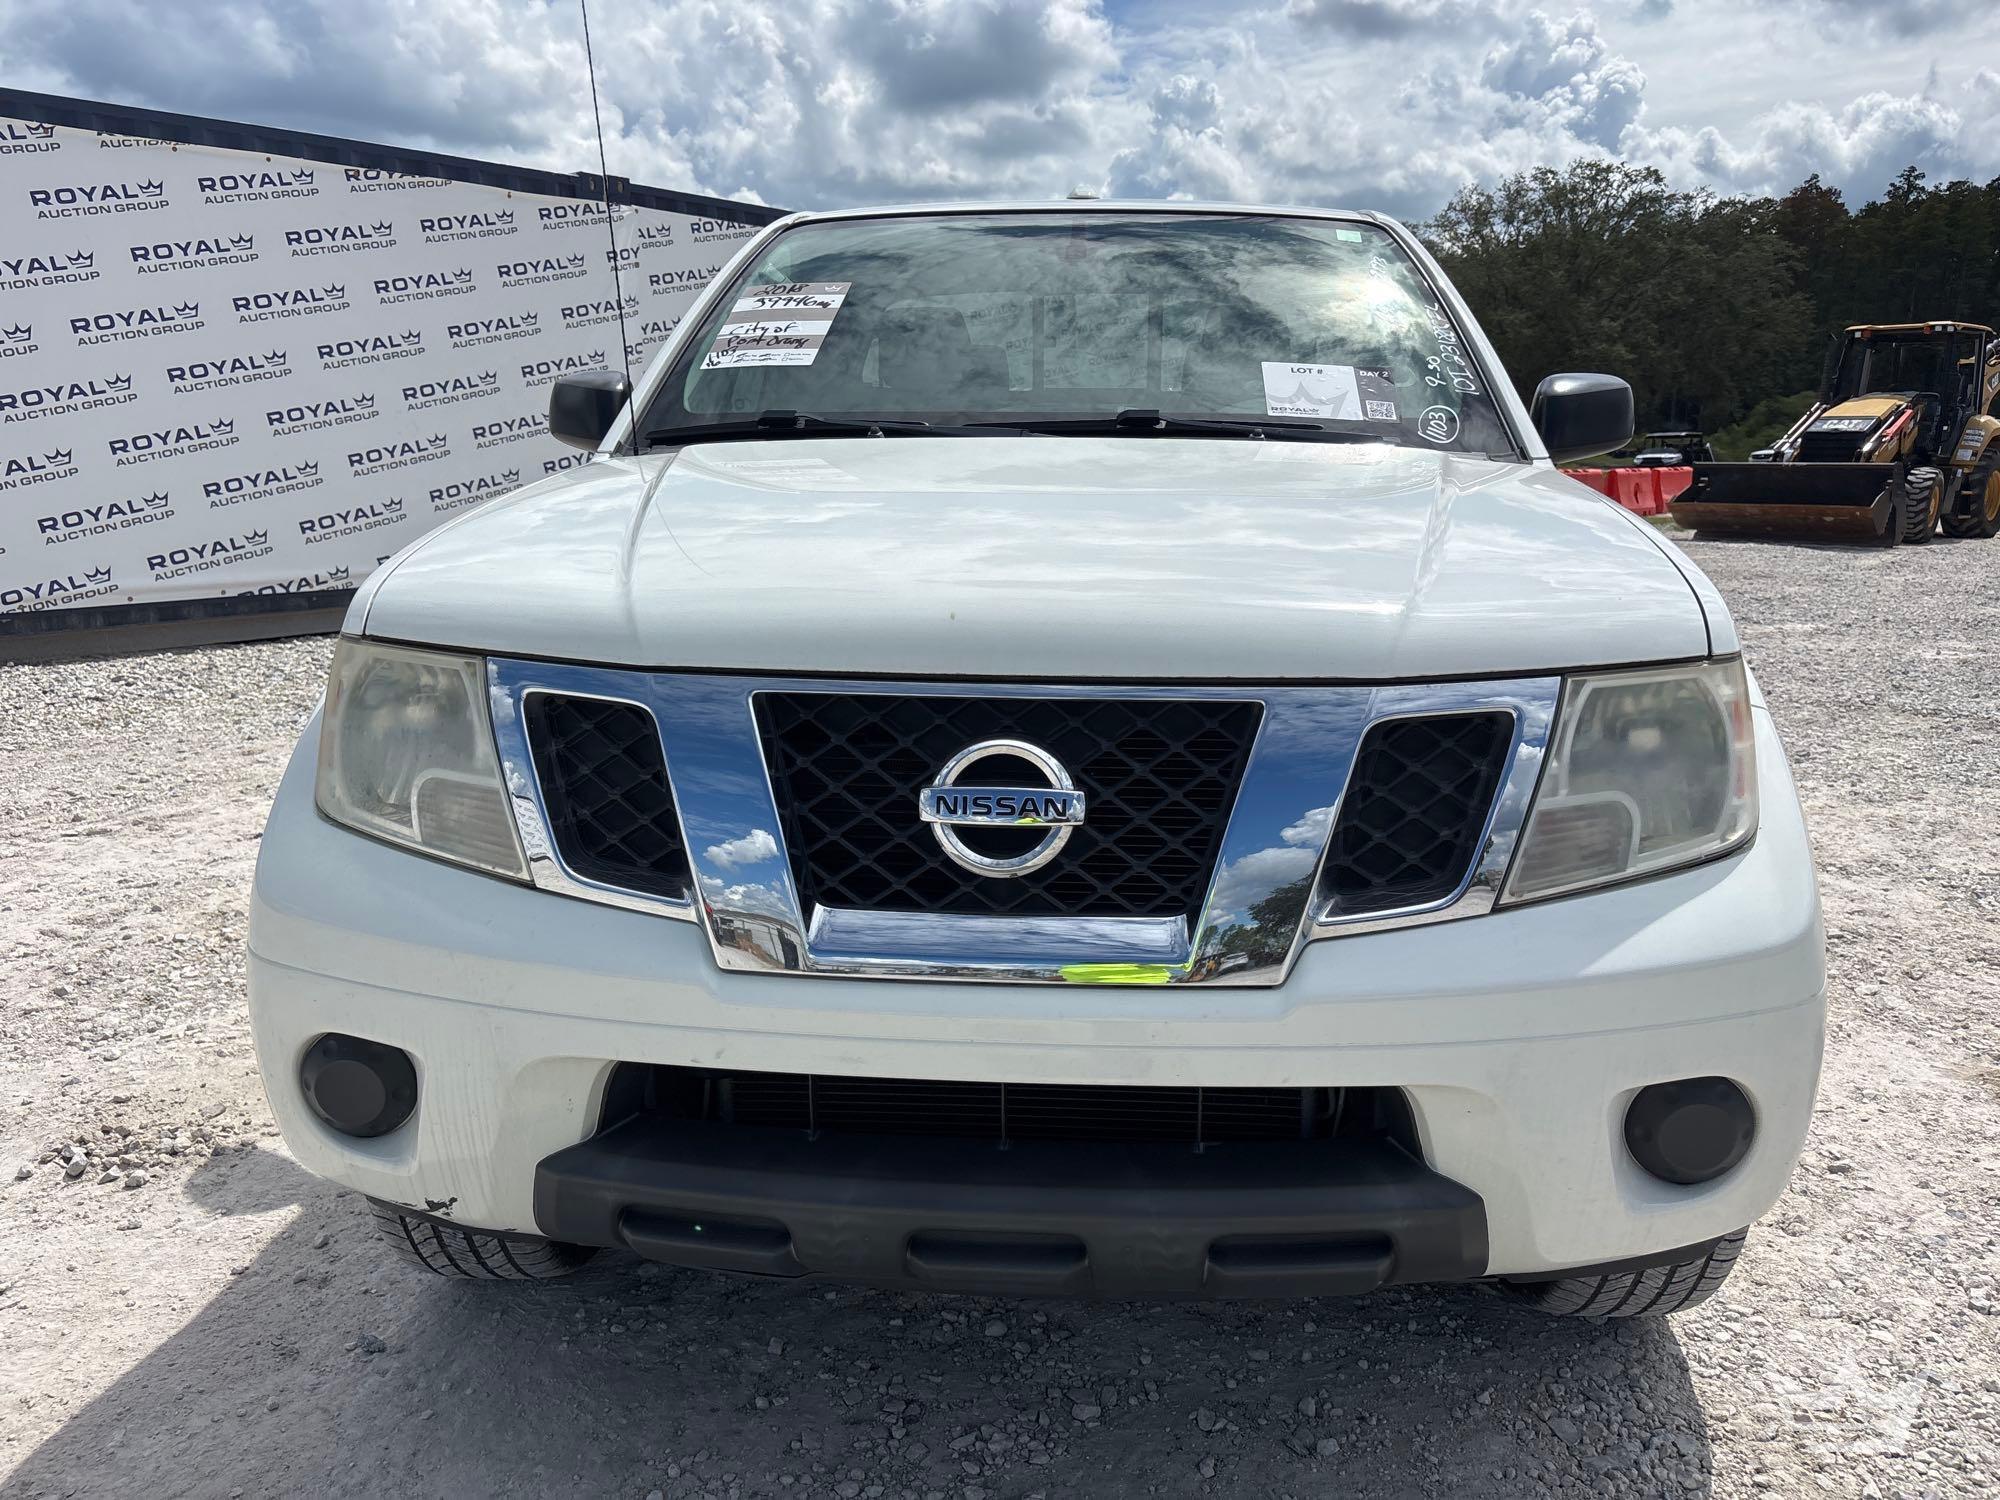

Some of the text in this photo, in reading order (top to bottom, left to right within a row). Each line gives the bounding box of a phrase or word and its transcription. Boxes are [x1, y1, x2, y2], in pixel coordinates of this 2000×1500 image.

[2, 142, 61, 154] GROUP
[198, 172, 292, 192] ROYAL
[350, 180, 452, 193] AUCTION GROUP
[30, 184, 139, 206] ROYAL
[205, 188, 319, 204] AUCTION GROUP
[38, 200, 170, 219] AUCTION GROUP
[538, 202, 606, 220] ROYAL
[420, 213, 496, 232] ROYAL
[542, 219, 589, 230] AUCTION
[285, 225, 372, 245] ROYAL
[425, 227, 518, 243] AUCTION GROUP
[642, 240, 673, 249] GROUP
[693, 234, 731, 243] AUCTION
[130, 239, 230, 262] ROYAL
[291, 239, 397, 257] AUCTION GROUP
[0, 256, 68, 276] YAL
[138, 254, 259, 274] AUCTION GROUP
[497, 258, 568, 278] ROYAL
[0, 271, 100, 290] TION GROUP
[374, 273, 454, 294] ROYAL
[502, 270, 587, 288] AUCTION GROUP
[649, 268, 707, 286] ROYAL
[232, 289, 324, 311] ROYAL
[380, 285, 476, 304] AUCTION GROUP
[652, 284, 692, 296] AUCTION
[239, 302, 350, 323] AUCTION GROUP
[561, 299, 625, 319] ROYAL
[70, 308, 175, 334] ROYAL
[448, 317, 521, 339] ROYAL
[565, 316, 609, 329] AUCTION
[78, 321, 204, 346] AUCTION GROUP
[452, 328, 542, 349] AUCTION GROUP
[317, 335, 402, 359] ROYAL
[167, 356, 264, 382] ROYAL
[323, 347, 425, 370] AUCTION GROUP
[521, 355, 589, 378] ROYAL
[174, 369, 292, 394] AUCTION GROUP
[402, 376, 479, 400] ROYAL
[0, 381, 106, 411] ROYAL
[408, 387, 501, 411] AUCTION GROUP
[4, 393, 138, 423] AUCTION GROUP
[266, 399, 355, 425] ROYAL
[272, 410, 379, 437] AUCTION GROUP
[472, 415, 543, 440] ROYAL
[109, 426, 210, 455] ROYAL
[477, 433, 525, 450] AUCTION
[116, 437, 239, 467] AUCTION GROUP
[348, 440, 429, 467] ROYAL
[543, 451, 595, 474] ROYA
[353, 450, 451, 478] AUCTION GROUP
[20, 468, 78, 486] GROUP
[203, 468, 297, 498] ROYAL
[210, 478, 323, 509] AUCTION GROUP
[429, 475, 503, 502] ROYAL
[434, 494, 483, 513] AUCTION
[38, 500, 144, 533] ROYAL
[46, 510, 175, 545] AUCTION GROUP
[299, 504, 383, 534] ROYAL
[305, 513, 407, 544] AUCTION GROUP
[147, 538, 245, 571] ROYAL
[154, 546, 273, 582] AUCTION GROUP
[0, 576, 86, 605] OYAL
[61, 584, 119, 603] GROUP
[936, 795, 1068, 817] NISSAN
